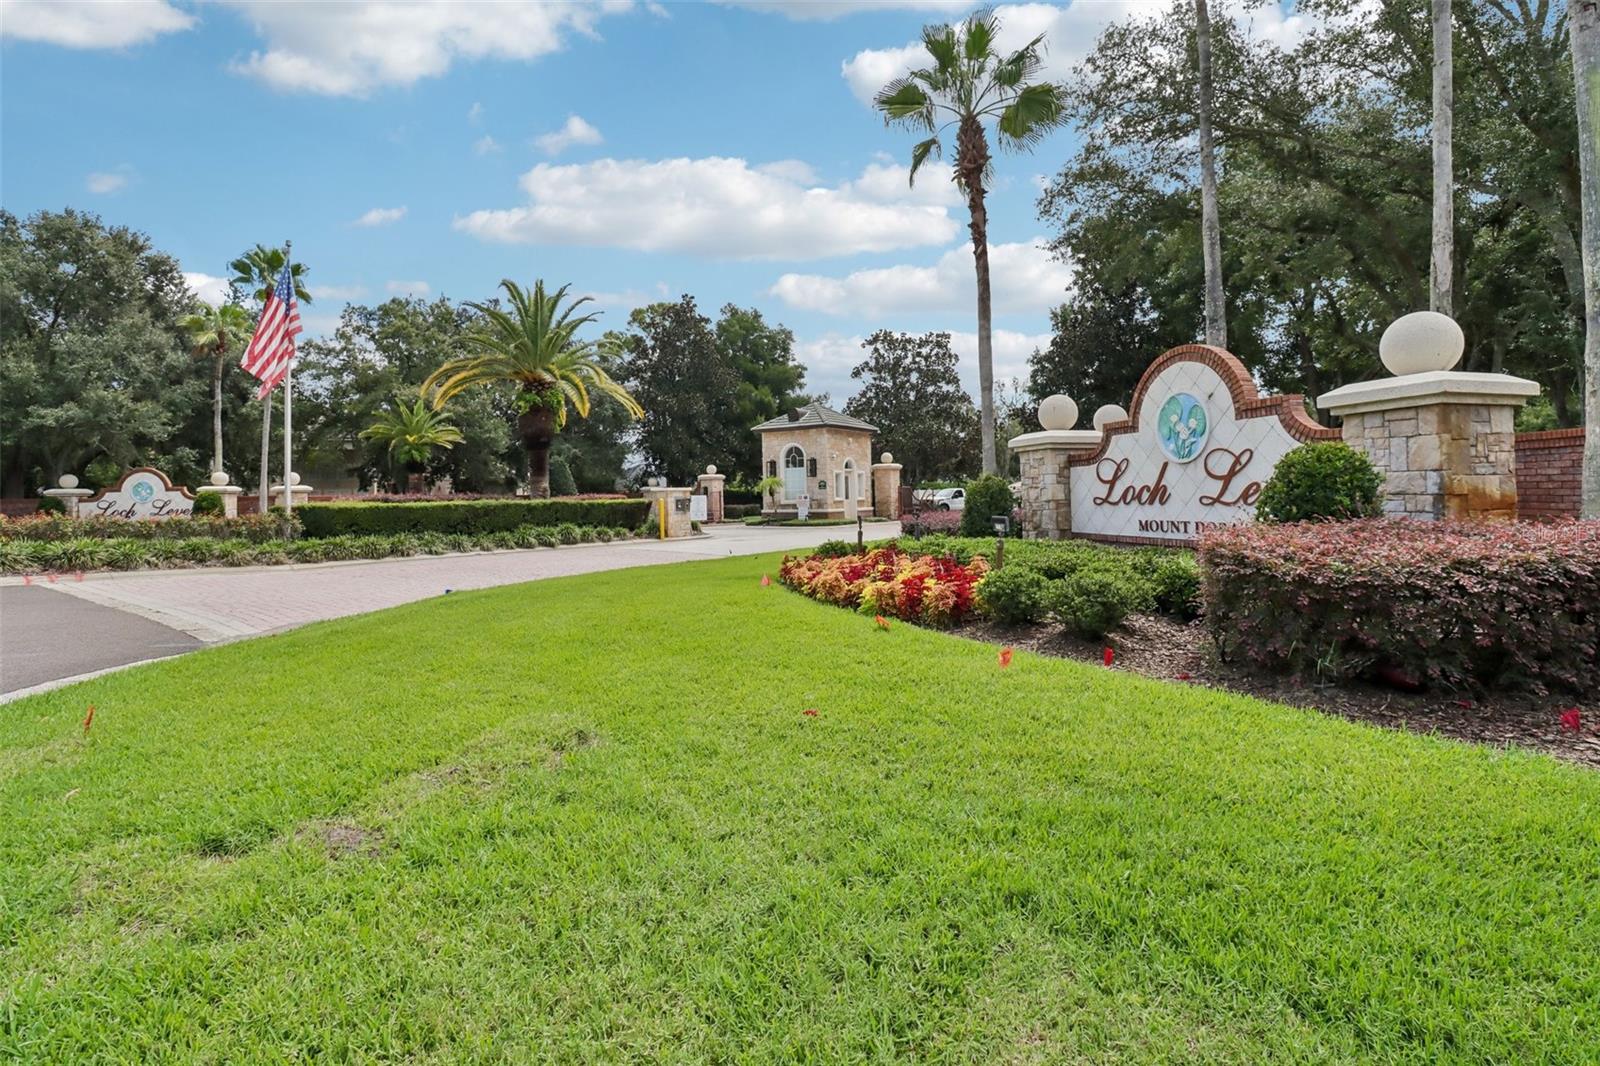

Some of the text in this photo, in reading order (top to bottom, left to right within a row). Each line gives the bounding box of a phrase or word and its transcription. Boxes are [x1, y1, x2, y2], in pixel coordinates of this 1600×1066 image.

[1093, 459, 1171, 506] Loch
[97, 500, 137, 519] Loch
[1138, 520, 1190, 534] MOUNT
